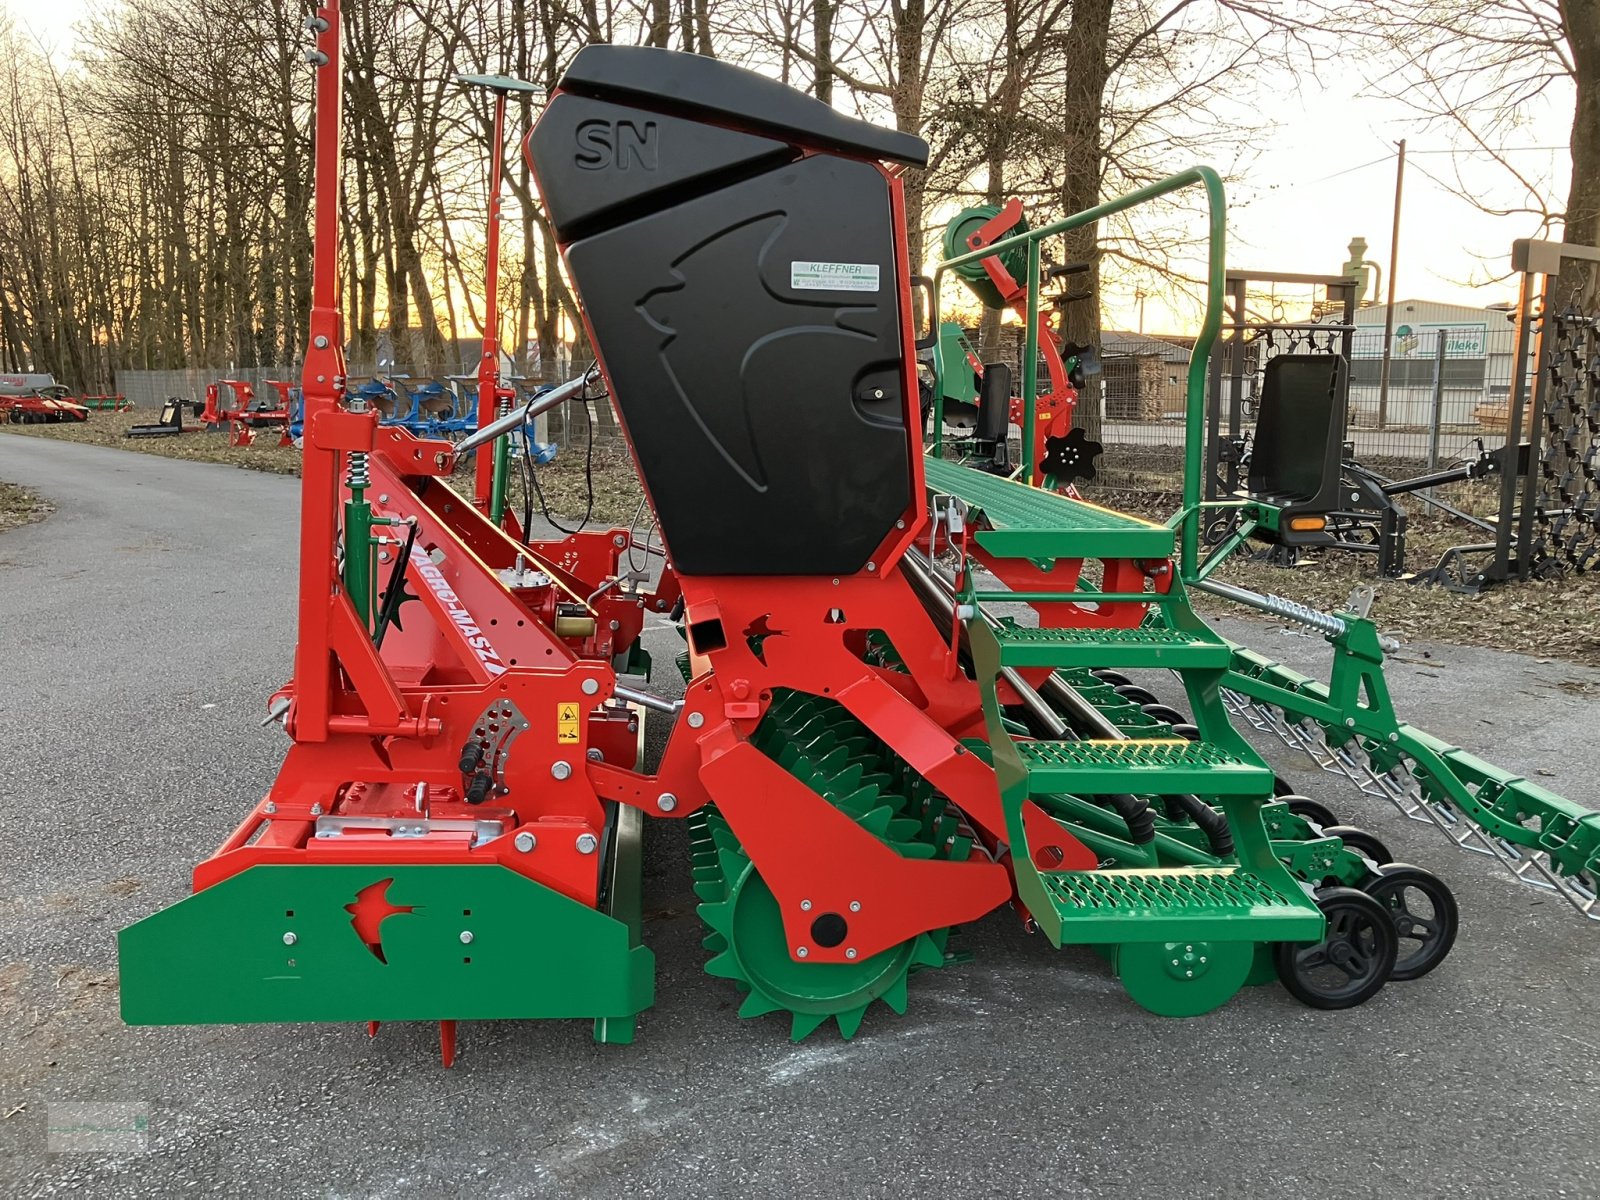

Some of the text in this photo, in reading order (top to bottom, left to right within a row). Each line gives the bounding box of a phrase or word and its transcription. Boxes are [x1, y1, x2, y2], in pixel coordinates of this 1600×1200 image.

[575, 119, 657, 170] SN
[809, 263, 862, 273] KLEFFNER
[1445, 340, 1479, 350] illeke
